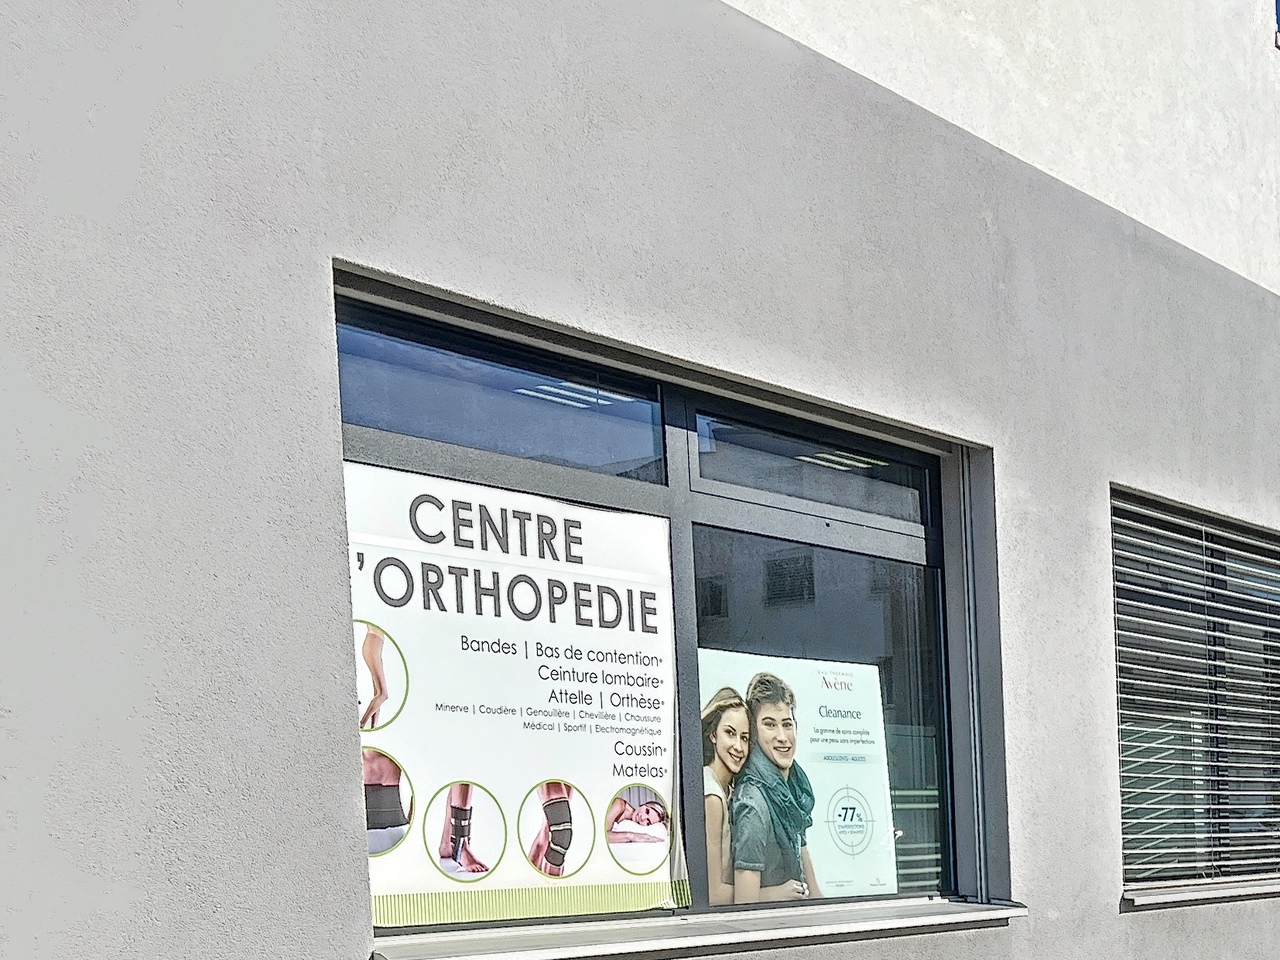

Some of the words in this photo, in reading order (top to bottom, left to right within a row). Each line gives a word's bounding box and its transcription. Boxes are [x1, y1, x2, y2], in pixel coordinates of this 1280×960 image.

[409, 494, 584, 565] CENTRE
[356, 552, 659, 635] 'ORTHOPEDIE
[461, 635, 517, 655] Bandes
[535, 642, 560, 659] Bas
[564, 646, 583, 661] de
[587, 649, 659, 667] contention
[538, 665, 598, 684] Ceinture
[602, 669, 660, 688] lombaire
[821, 676, 853, 692] Avène
[548, 689, 593, 706] Attelle
[609, 692, 661, 710] Orthèse
[435, 703, 469, 713] Minerve
[479, 704, 517, 716] Coudière
[526, 707, 570, 719] Genouillère
[624, 712, 661, 723] Chaussure
[818, 705, 862, 720] Cleanance
[523, 721, 555, 731] Médical
[563, 723, 587, 733] Sportif
[595, 725, 662, 737] Electromagnétique
[614, 741, 663, 756] Coussin
[612, 763, 664, 778] Matelas
